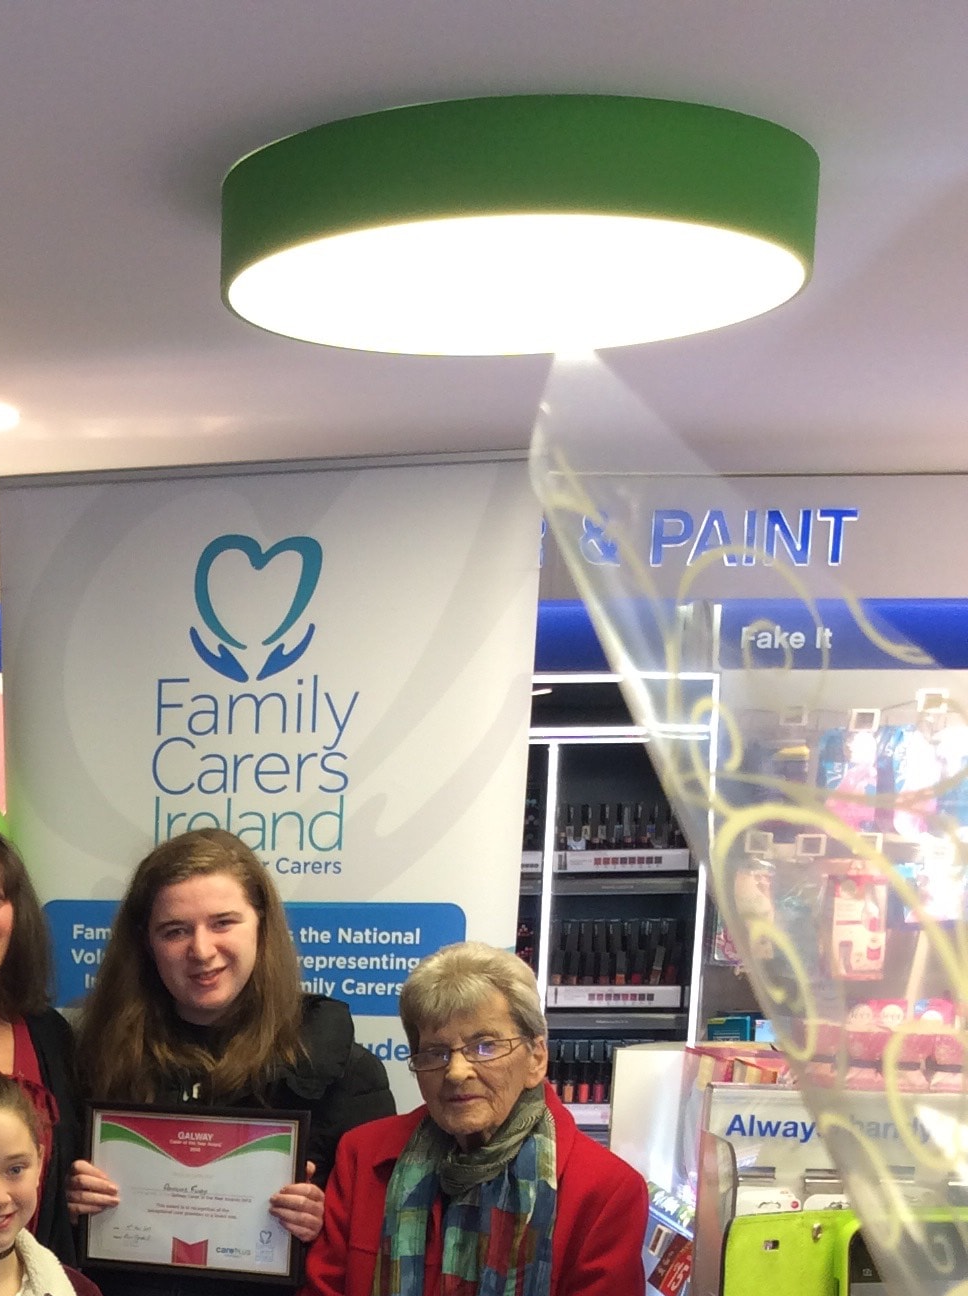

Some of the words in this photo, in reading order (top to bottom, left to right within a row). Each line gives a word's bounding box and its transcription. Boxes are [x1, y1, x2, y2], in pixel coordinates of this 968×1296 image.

[649, 508, 860, 568] PAINT
[740, 625, 806, 650] Fake
[815, 626, 834, 650] It
[155, 675, 360, 751] Family
[152, 737, 350, 797] Carers
[275, 857, 342, 875] Carers
[73, 924, 112, 940] Fam
[299, 926, 332, 944] the
[337, 927, 421, 945] National
[71, 948, 105, 965] Vol
[297, 953, 420, 974] representing
[341, 978, 404, 996] Carers
[177, 1131, 214, 1142] GALWAY
[726, 1114, 820, 1144] Alway
